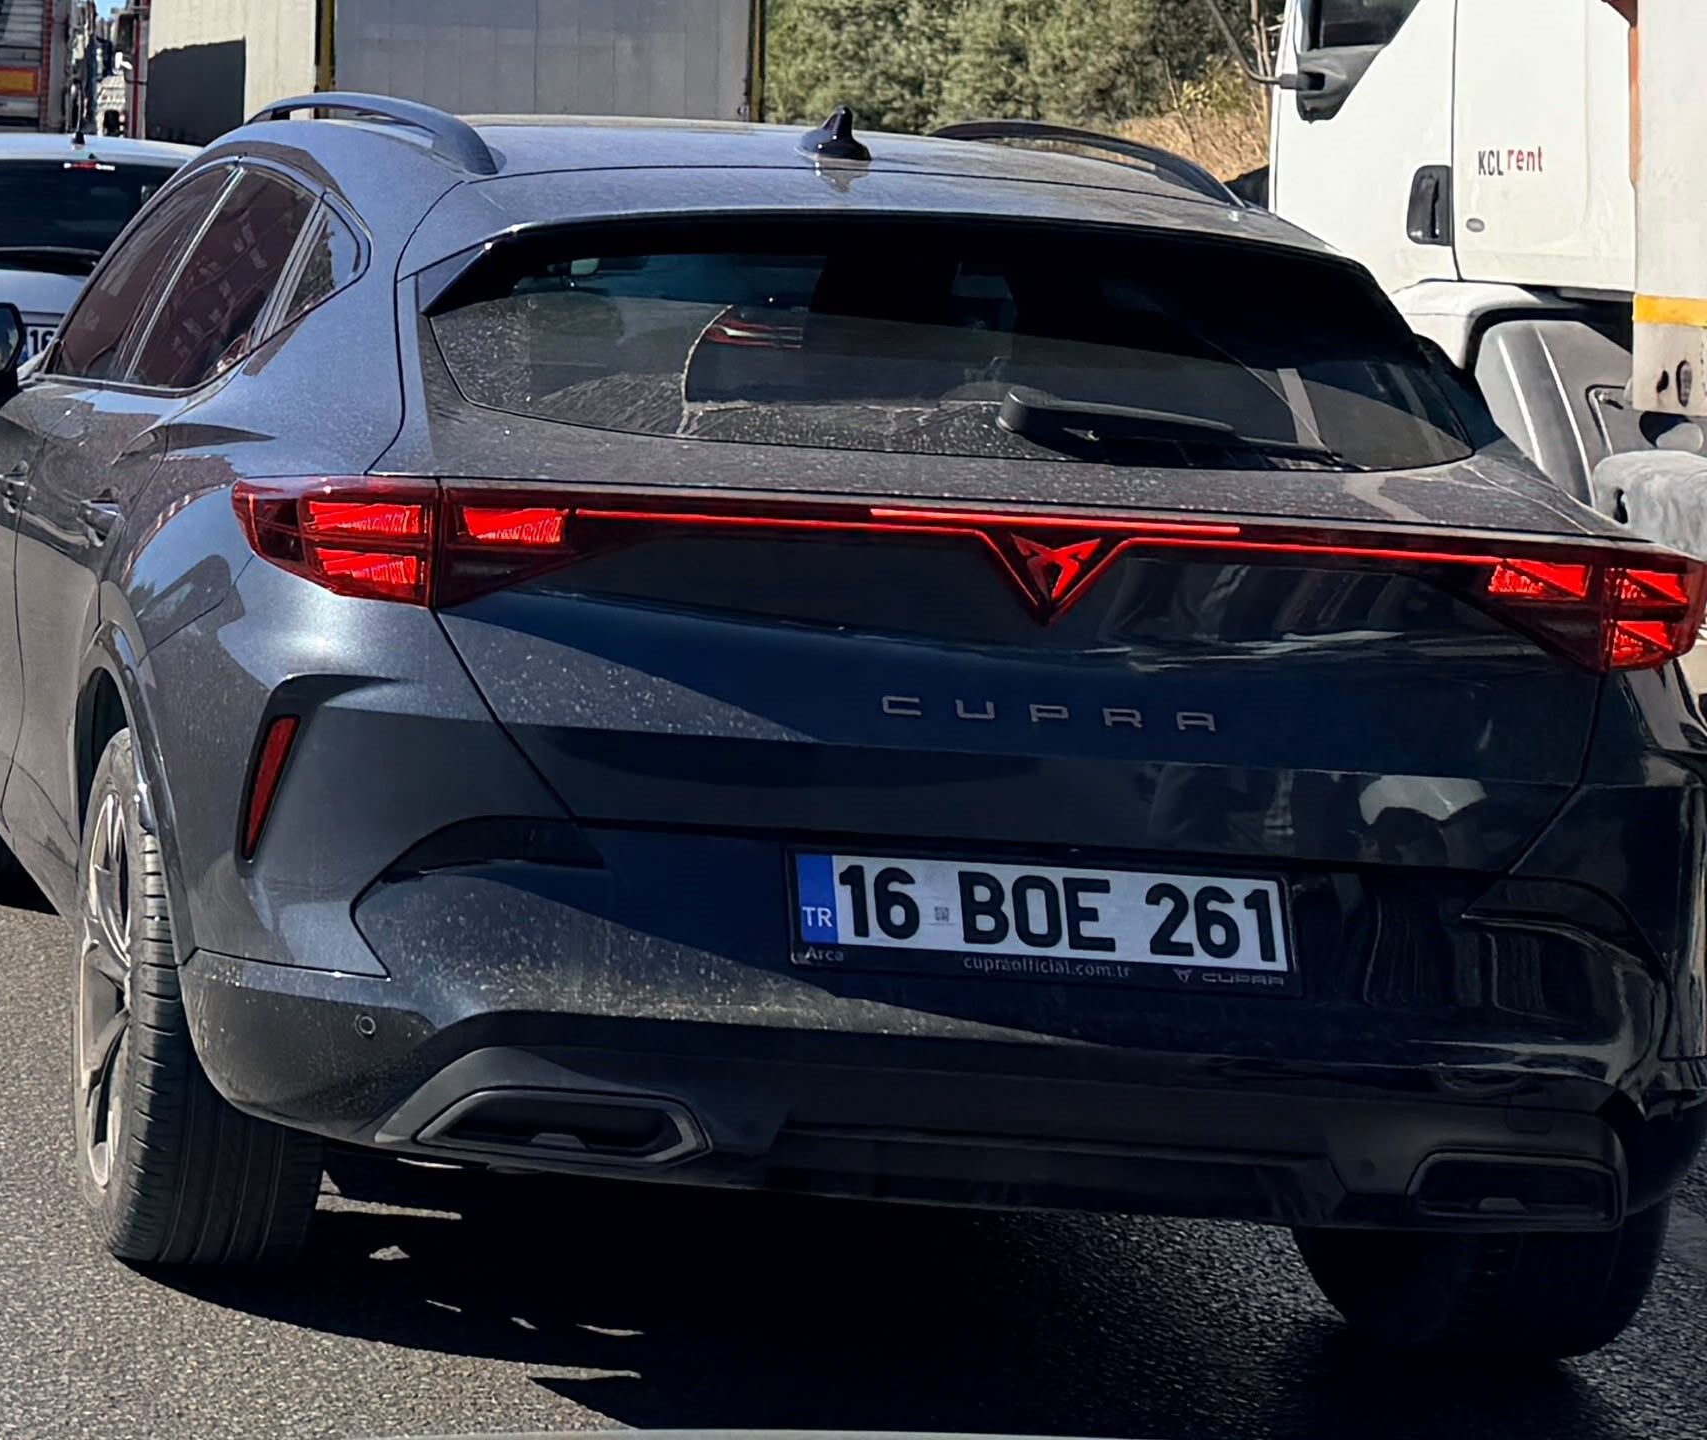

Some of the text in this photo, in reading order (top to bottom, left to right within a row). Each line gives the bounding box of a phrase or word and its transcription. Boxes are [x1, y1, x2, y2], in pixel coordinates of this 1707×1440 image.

[1507, 145, 1543, 173] rent
[881, 695, 1217, 732] CUPRA
[801, 906, 833, 929] TR
[838, 863, 1278, 963] 16 BOE 261
[1201, 972, 1285, 986] CUPRA
